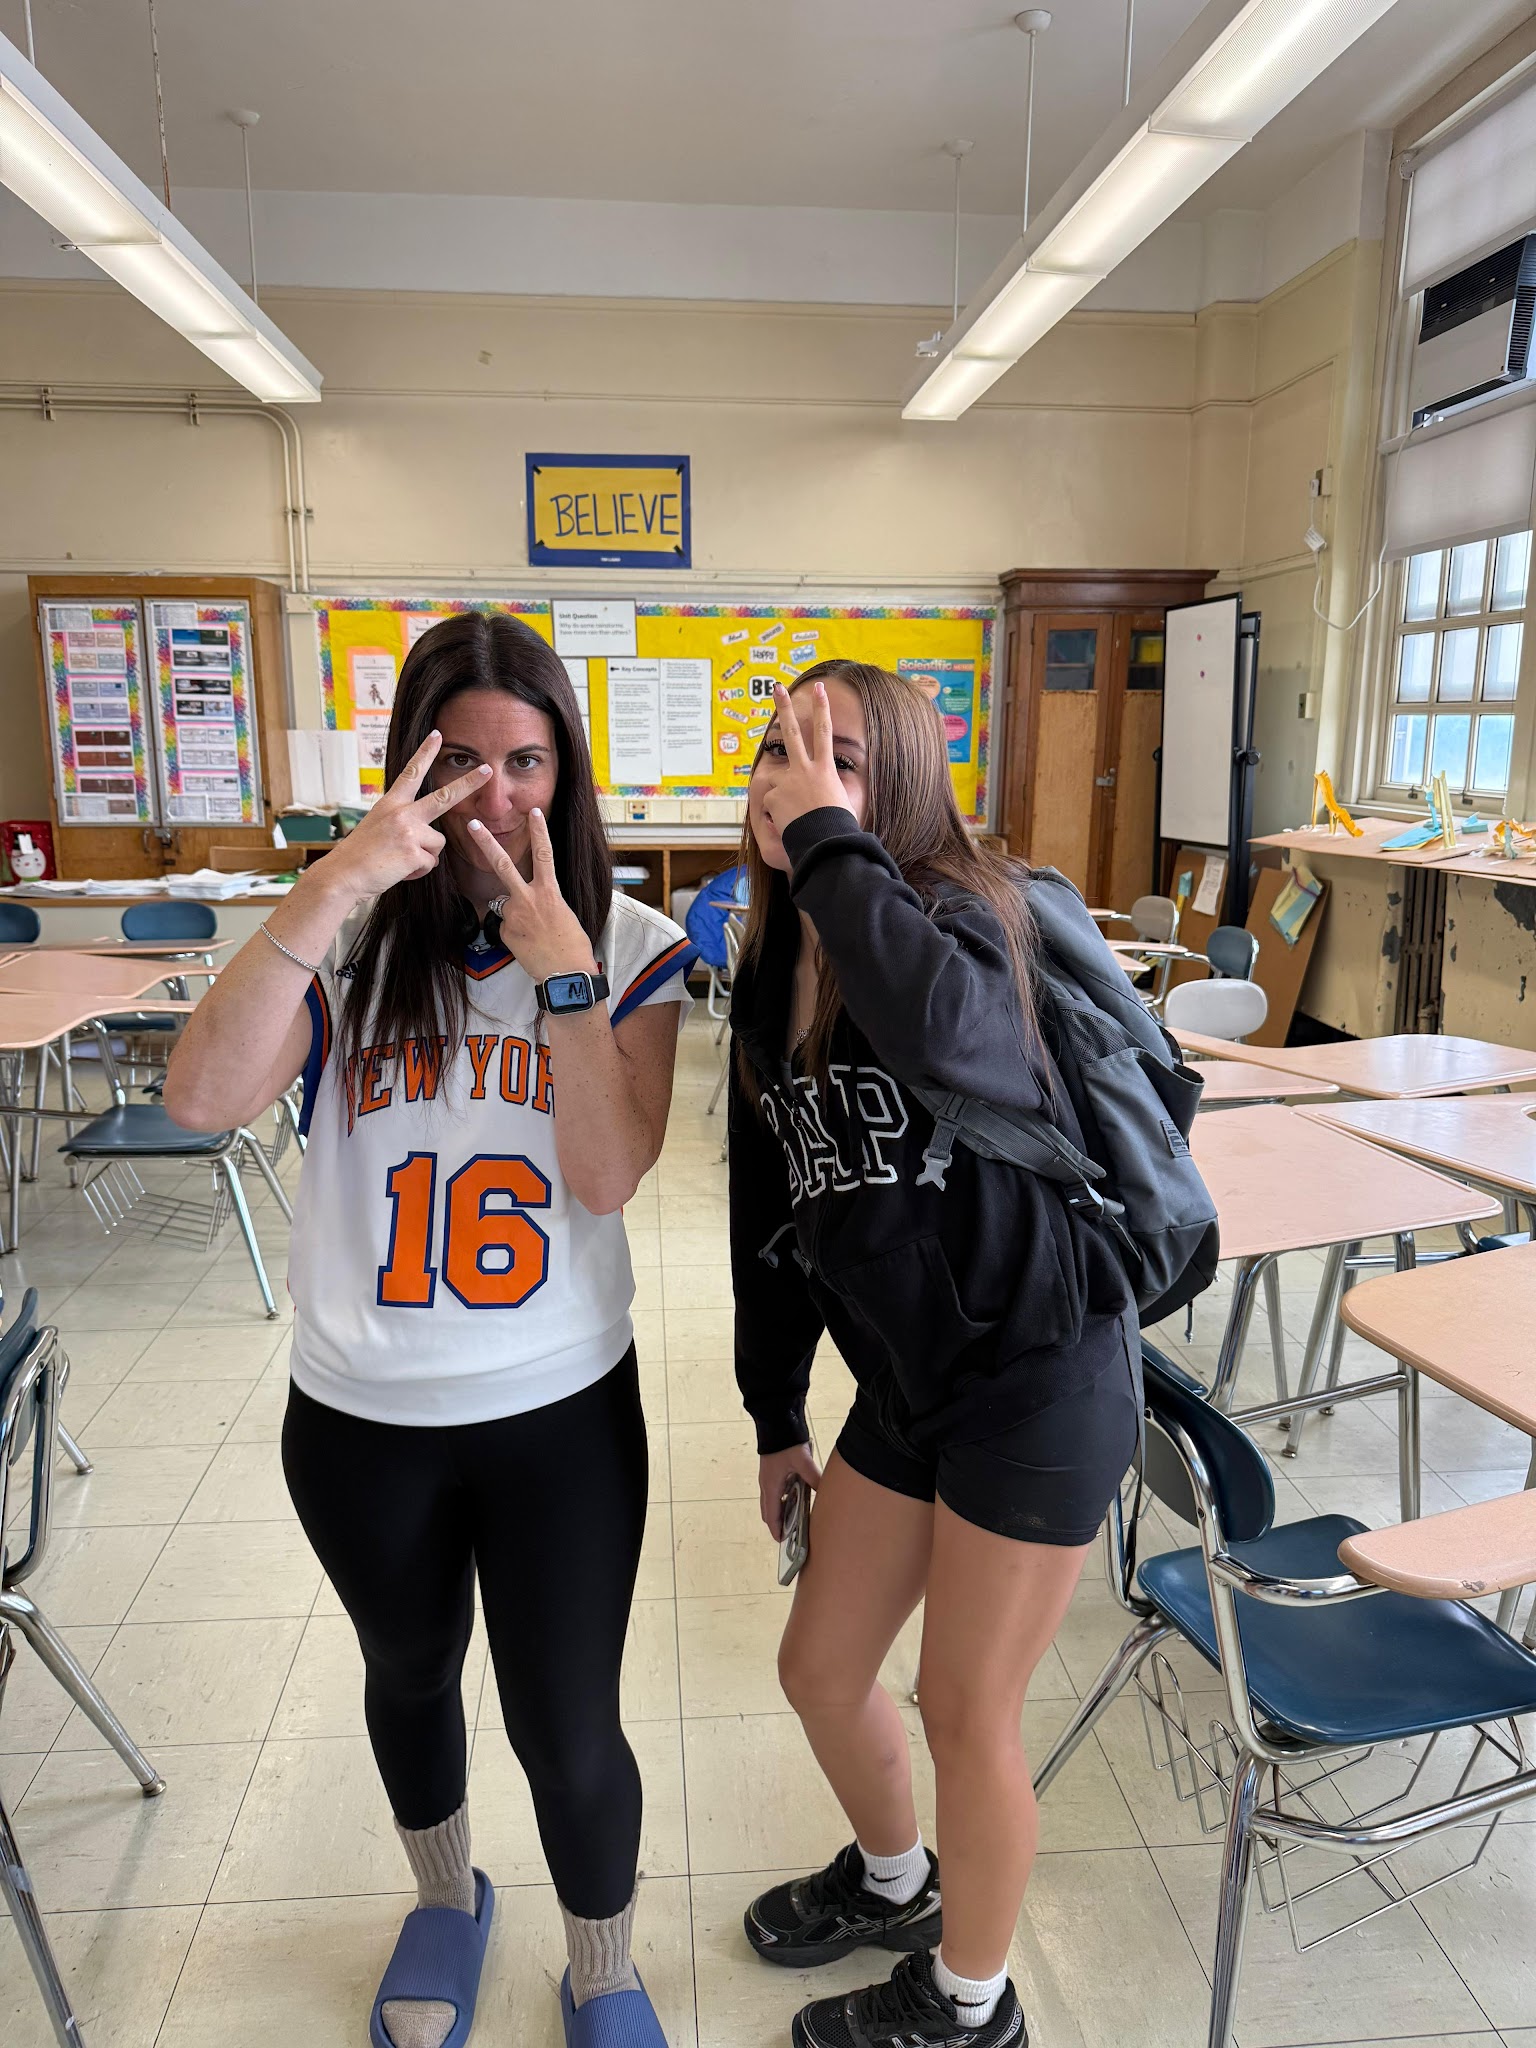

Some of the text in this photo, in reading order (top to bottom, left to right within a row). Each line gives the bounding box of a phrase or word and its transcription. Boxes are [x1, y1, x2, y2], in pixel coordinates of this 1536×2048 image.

[550, 493, 680, 537] BELIEVE
[753, 650, 775, 660] Happy
[752, 679, 774, 696] BE
[465, 1034, 556, 1118] YOR
[376, 1151, 552, 1309] 16
